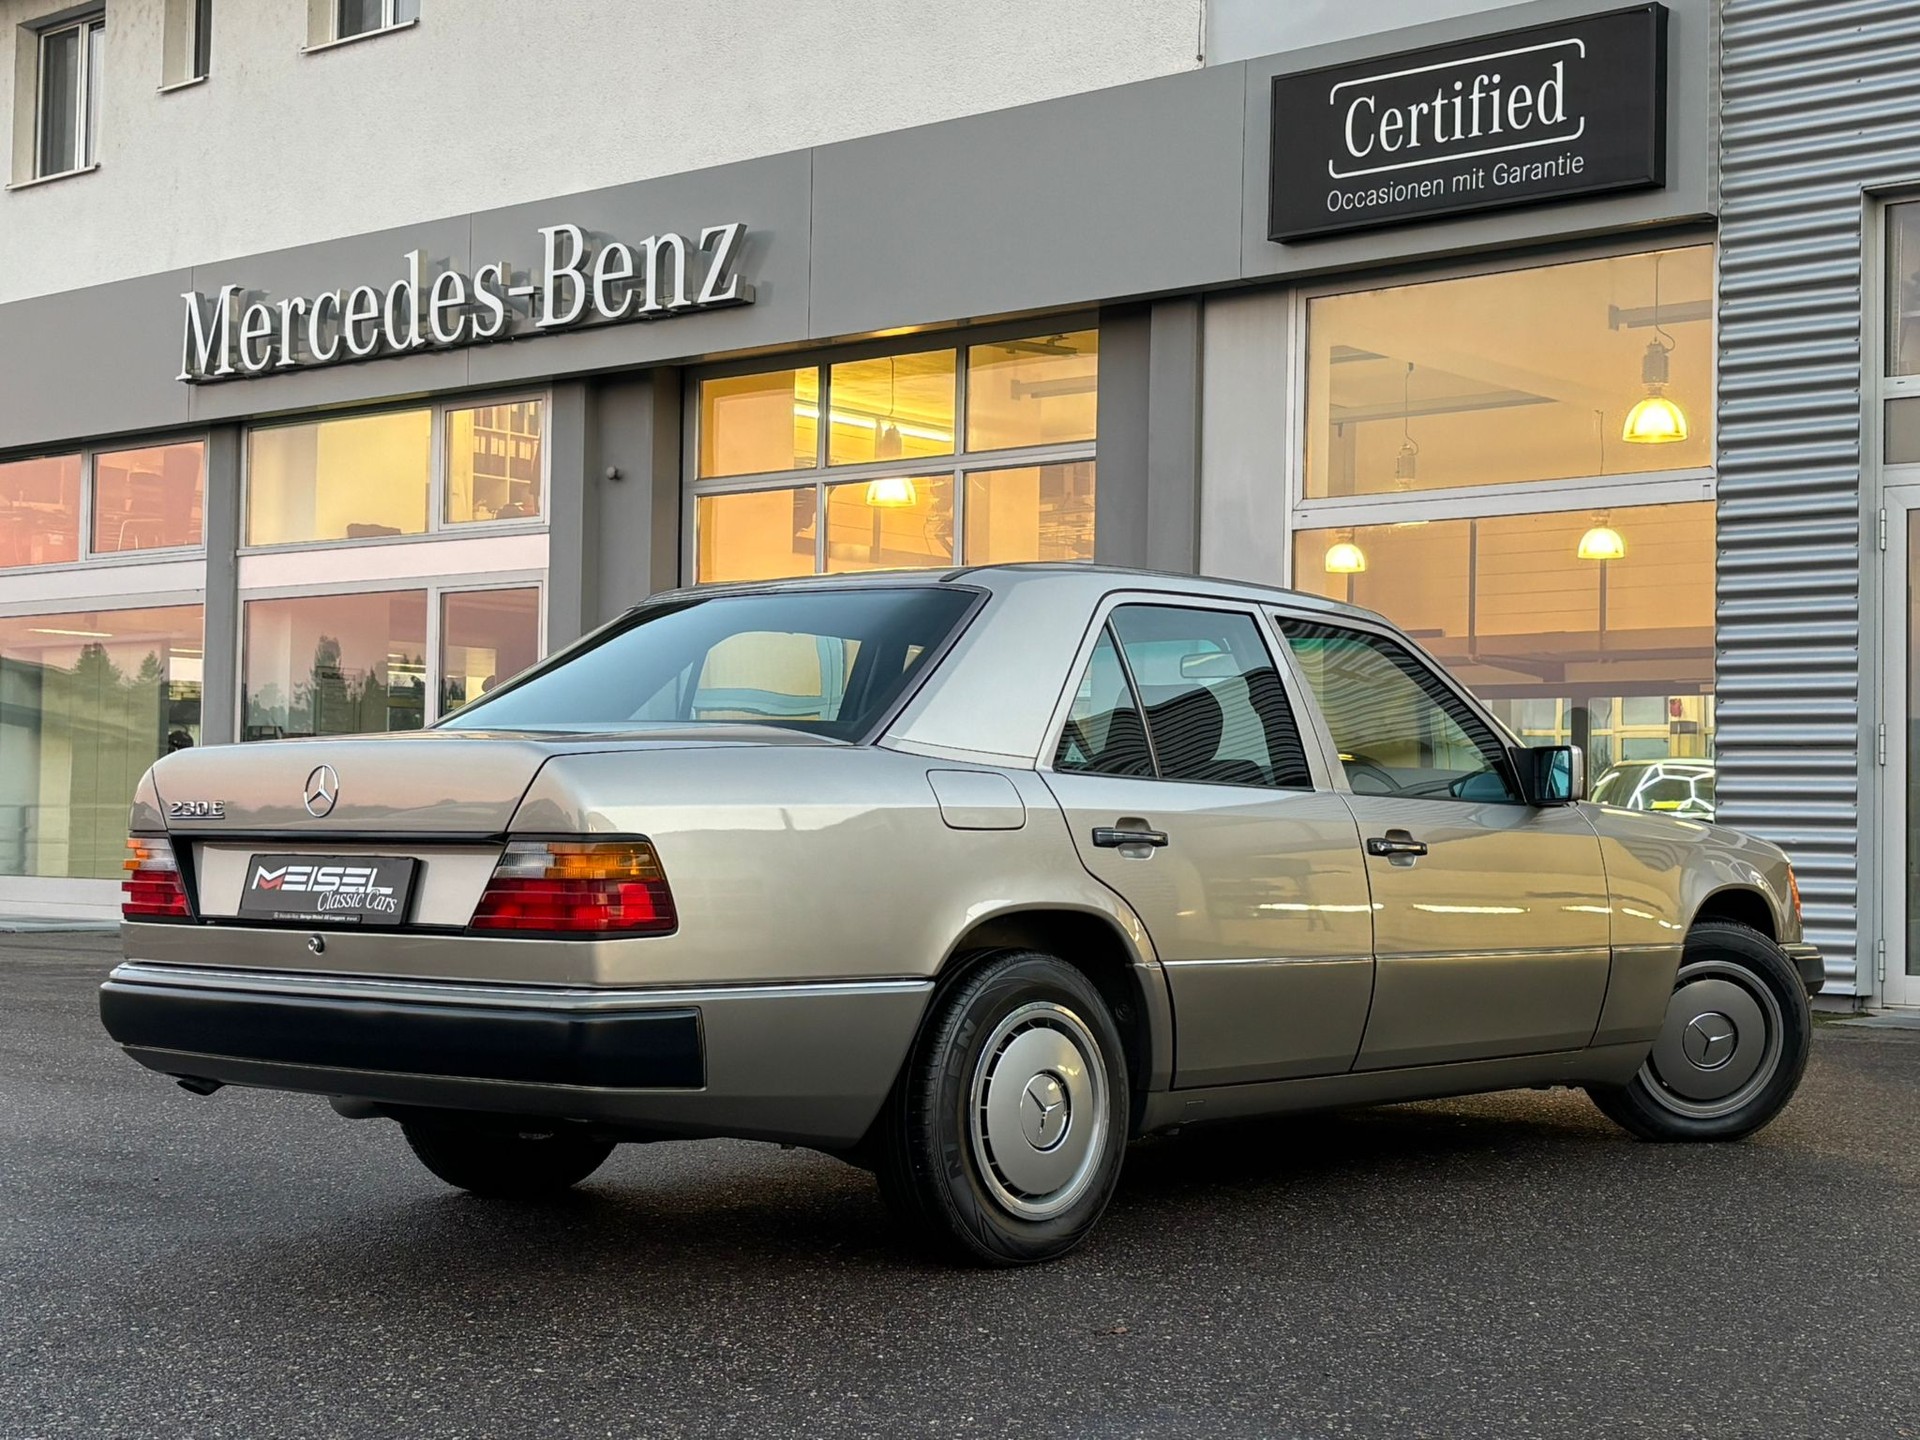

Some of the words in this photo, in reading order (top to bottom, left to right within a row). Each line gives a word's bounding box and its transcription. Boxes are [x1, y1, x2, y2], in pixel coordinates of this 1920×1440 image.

[1344, 60, 1567, 158] Certified
[1327, 180, 1444, 212] Occasionen
[1452, 168, 1485, 193] mit
[1492, 152, 1585, 187] Garantie
[176, 223, 742, 382] Mercedes-Benz
[251, 865, 393, 894] MEISEL
[317, 889, 362, 912] Classic
[366, 889, 398, 913] Cars
